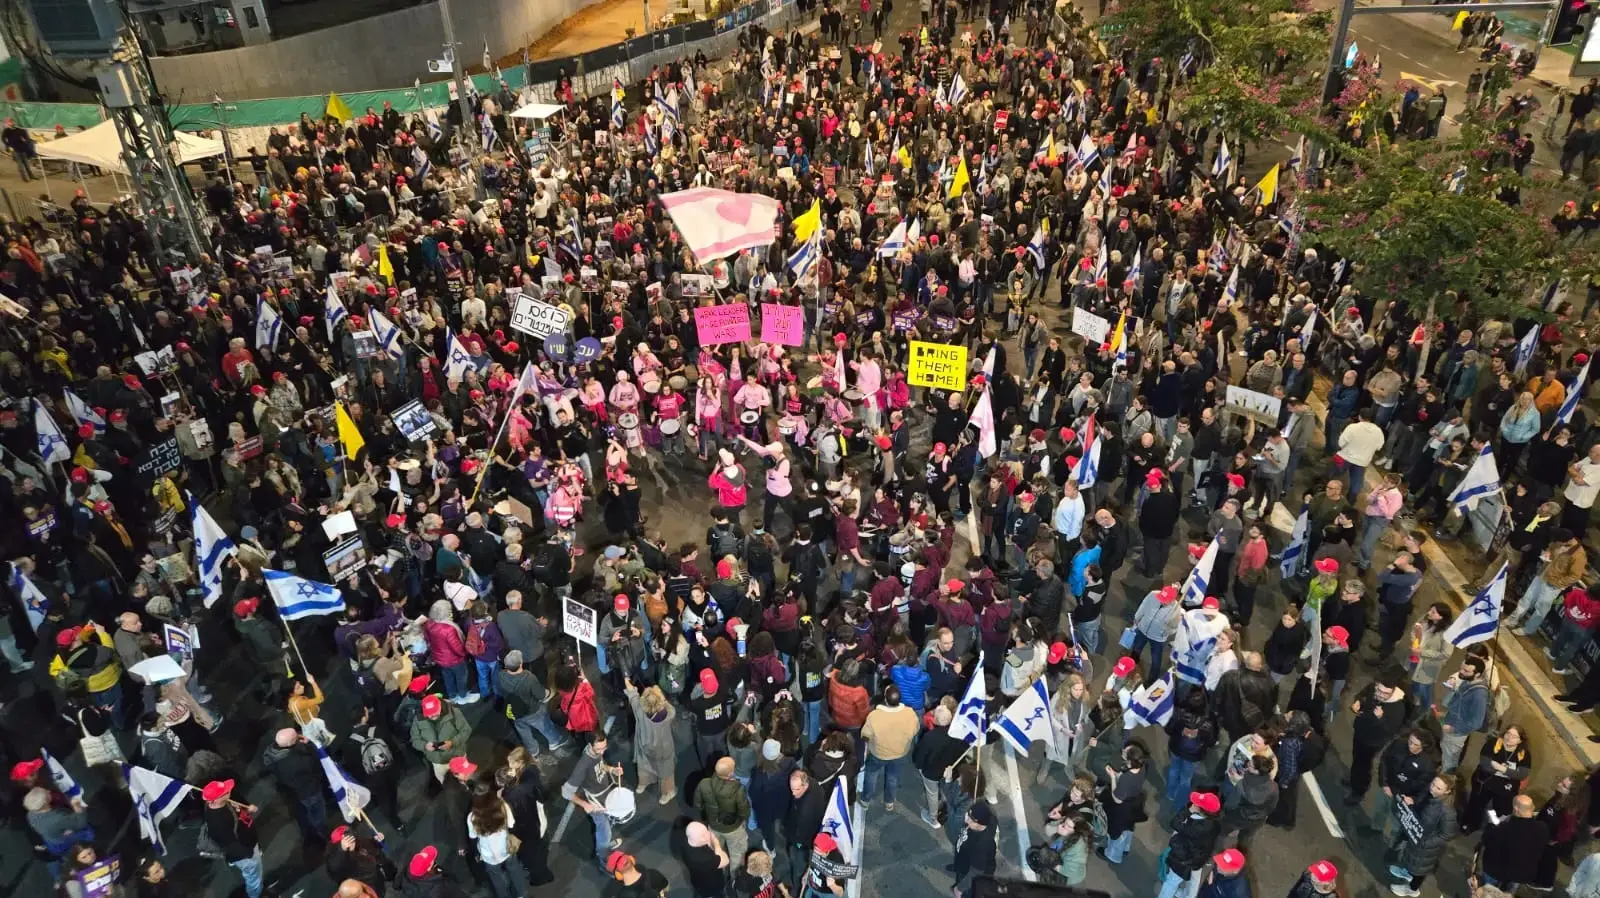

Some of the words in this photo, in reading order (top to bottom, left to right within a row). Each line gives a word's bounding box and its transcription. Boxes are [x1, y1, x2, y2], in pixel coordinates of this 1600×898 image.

[713, 328, 737, 339] WARS
[917, 346, 958, 361] BRING
[916, 372, 959, 388] HOME!
[150, 438, 177, 458] טבח
[154, 455, 180, 476] טבח
